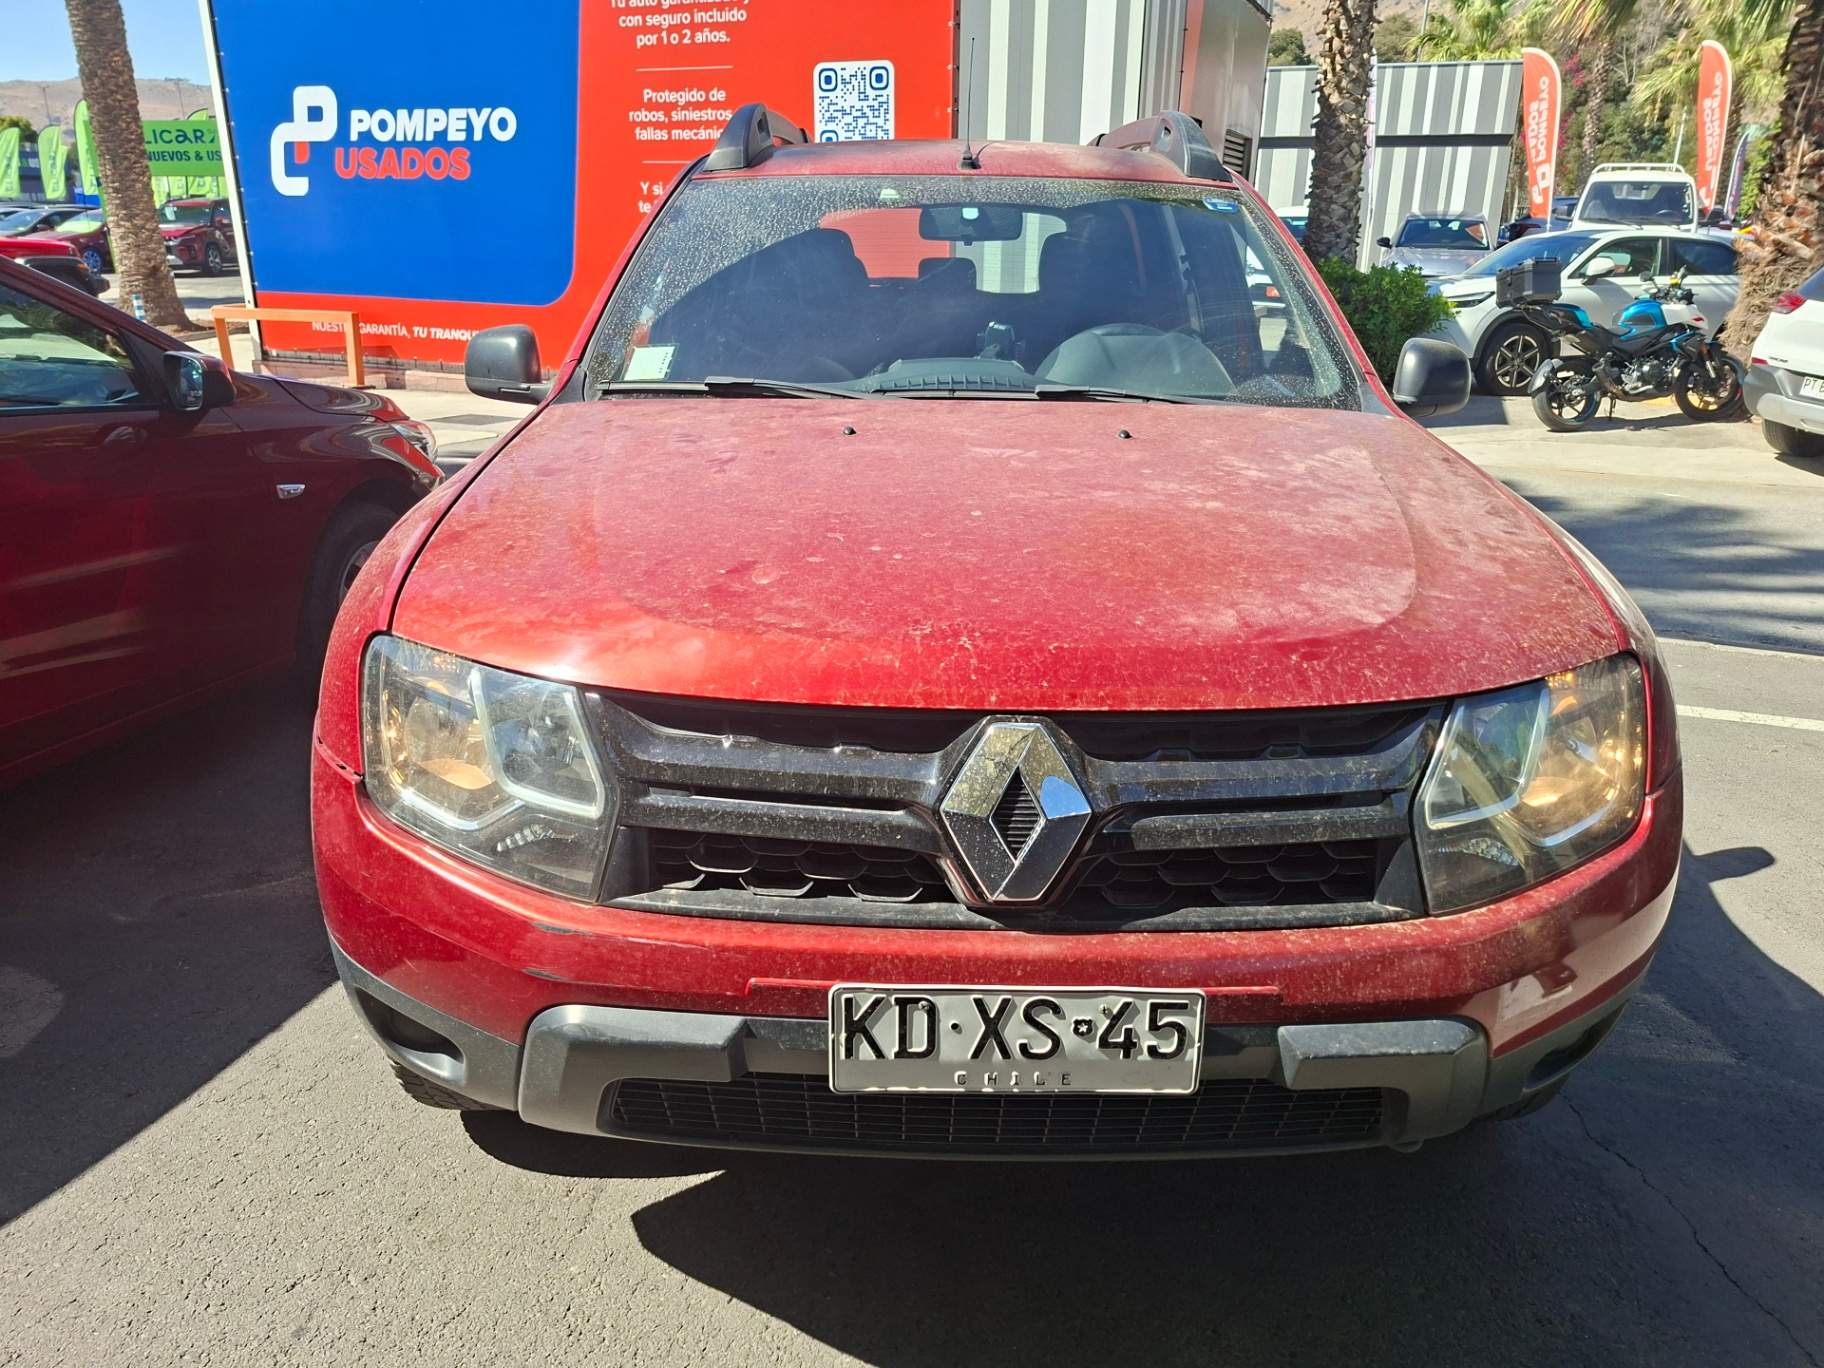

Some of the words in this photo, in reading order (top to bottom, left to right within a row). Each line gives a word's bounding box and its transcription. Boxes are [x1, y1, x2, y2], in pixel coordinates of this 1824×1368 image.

[618, 16, 642, 27] con
[645, 12, 690, 28] seguro
[694, 7, 747, 23] incluido
[636, 33, 658, 48] por
[661, 31, 667, 44] 1
[670, 33, 679, 44] o
[682, 29, 691, 43] 2
[694, 28, 731, 43] años.
[643, 88, 705, 105] Protegido
[709, 89, 726, 101] de
[629, 108, 668, 123] robos,
[671, 107, 732, 121] siniestros
[350, 107, 517, 142] POMPEYO
[635, 127, 668, 140] fallas
[194, 150, 204, 161] &
[335, 147, 471, 180] USADOS
[640, 181, 650, 195] Y
[652, 181, 663, 195] si
[638, 200, 651, 213] te
[413, 326, 428, 338] TU
[430, 327, 479, 341] TRANQU
[954, 1071, 1072, 1086] CHILE
